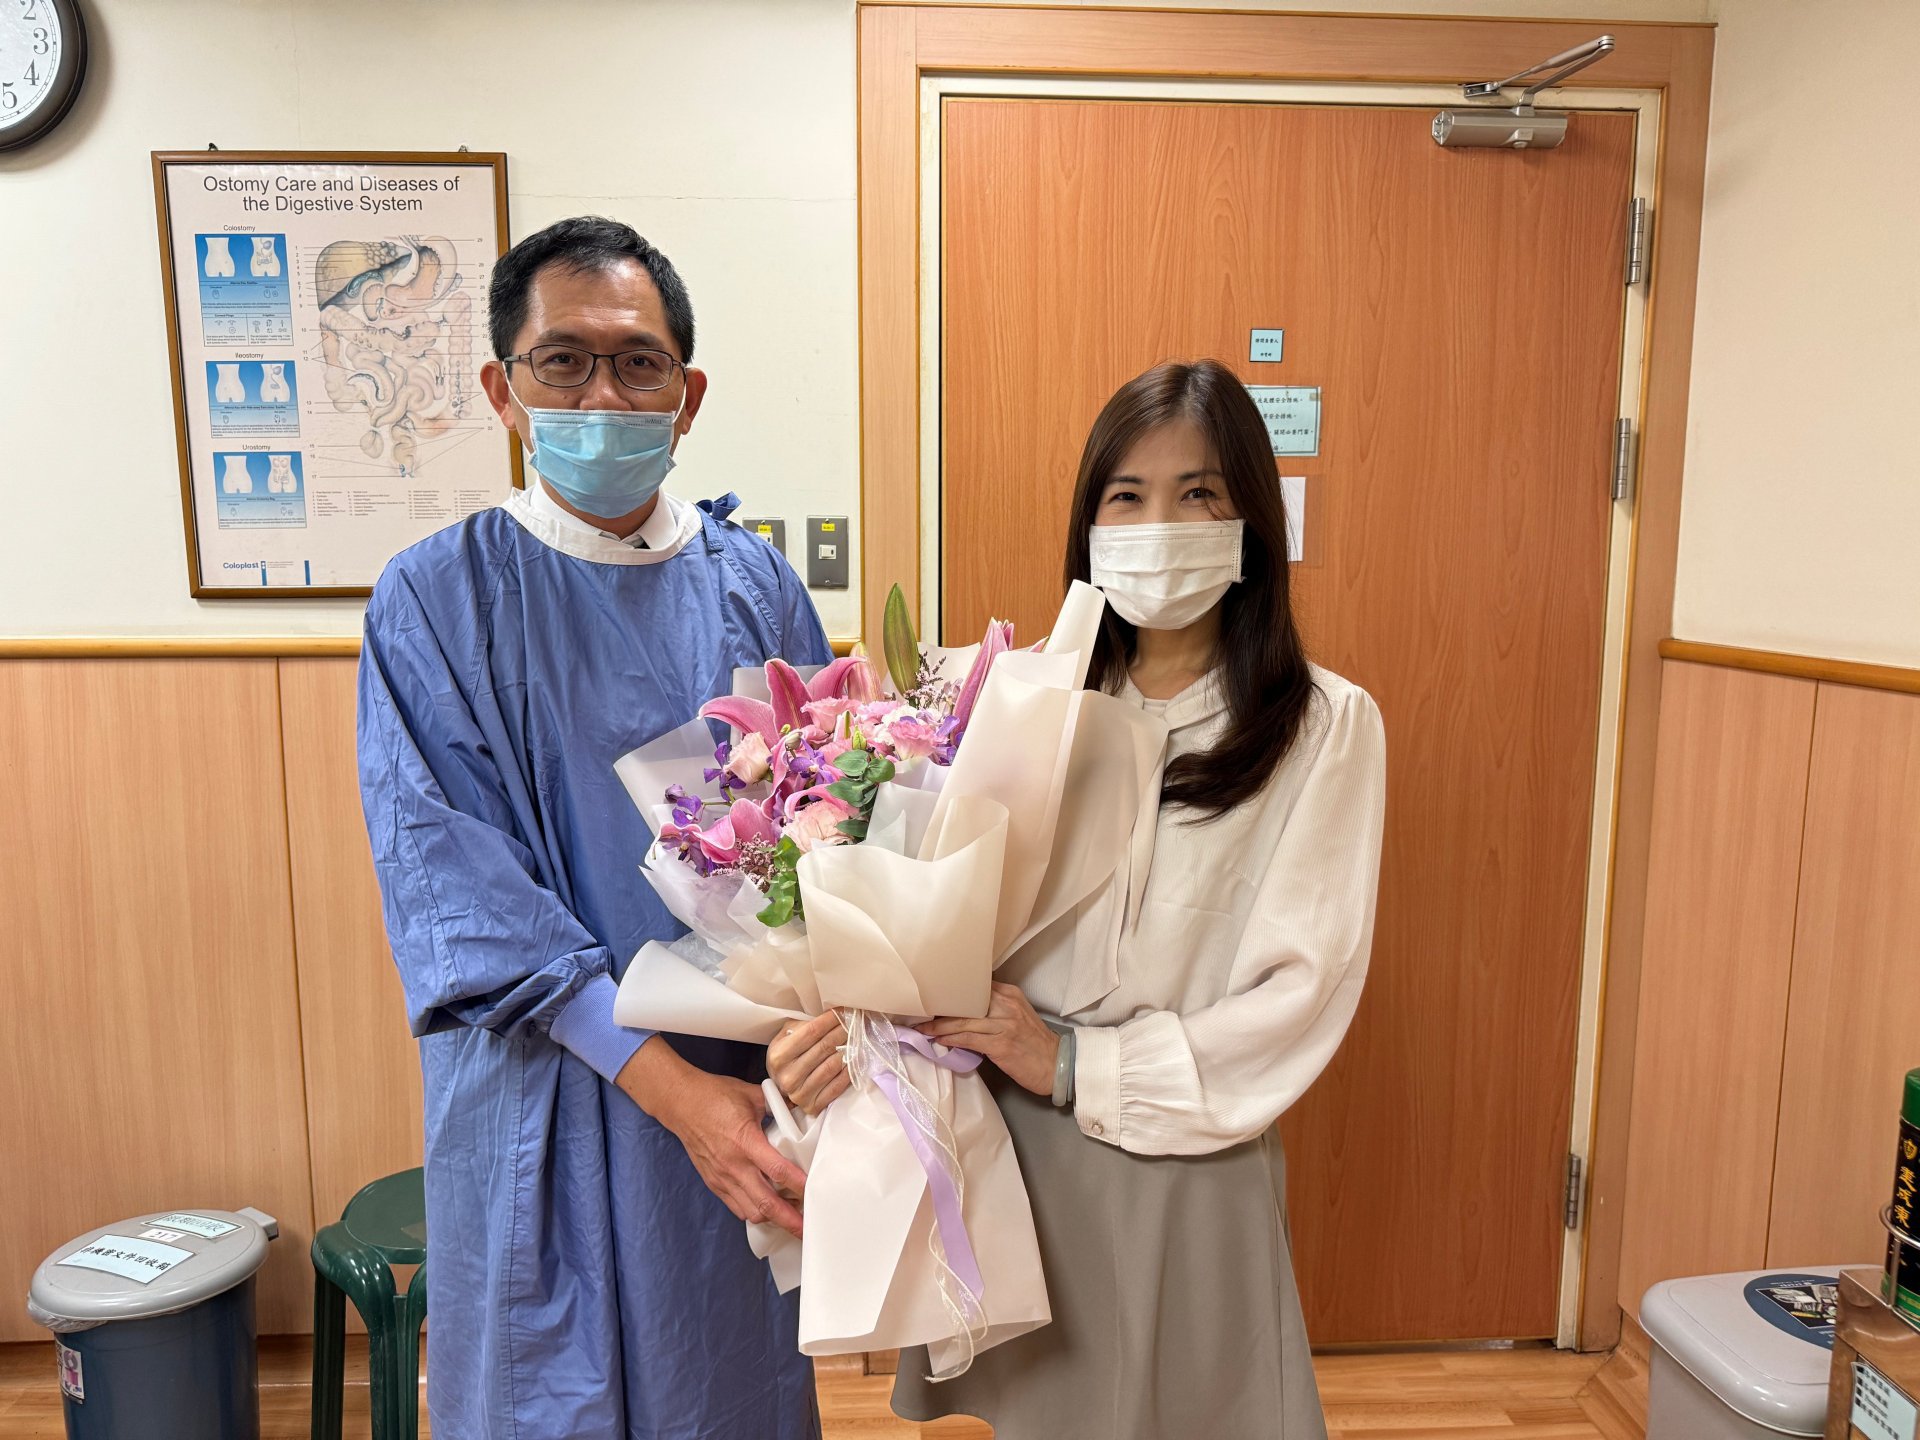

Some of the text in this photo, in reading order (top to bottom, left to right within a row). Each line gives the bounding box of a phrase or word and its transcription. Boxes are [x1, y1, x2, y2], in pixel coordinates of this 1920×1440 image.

[20, 0, 37, 20] 2
[33, 27, 49, 55] 3
[23, 58, 40, 86] 4
[2, 82, 17, 109] 5
[203, 175, 460, 195] Ostomy Care and Diseases of
[243, 195, 423, 214] the Digestive System
[223, 224, 256, 232] Colostomy
[223, 562, 259, 570] Coloplast
